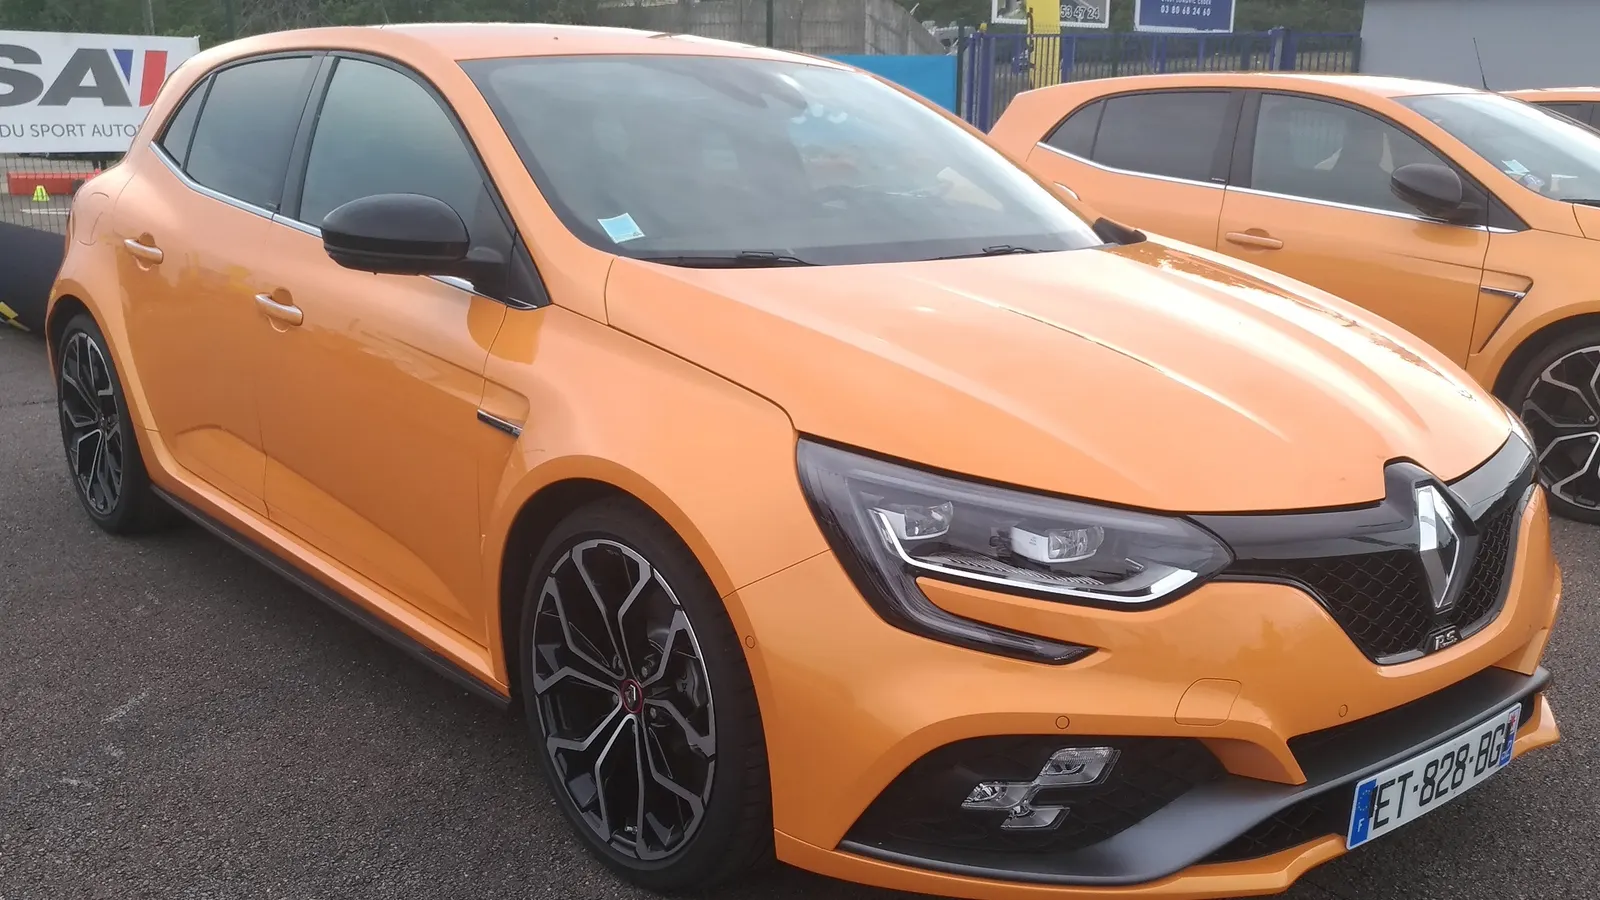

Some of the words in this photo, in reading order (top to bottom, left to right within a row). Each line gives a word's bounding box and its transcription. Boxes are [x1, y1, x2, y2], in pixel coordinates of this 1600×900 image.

[1060, 5, 1072, 18] 53
[1073, 6, 1086, 19] 47
[1087, 7, 1100, 19] 24
[1160, 5, 1169, 14] 03
[1171, 5, 1180, 15] 80
[1192, 7, 1200, 16] 24
[0, 124, 24, 138] DU
[30, 124, 86, 137] SPORT
[92, 124, 141, 137] AUTO
[1357, 817, 1365, 832] F
